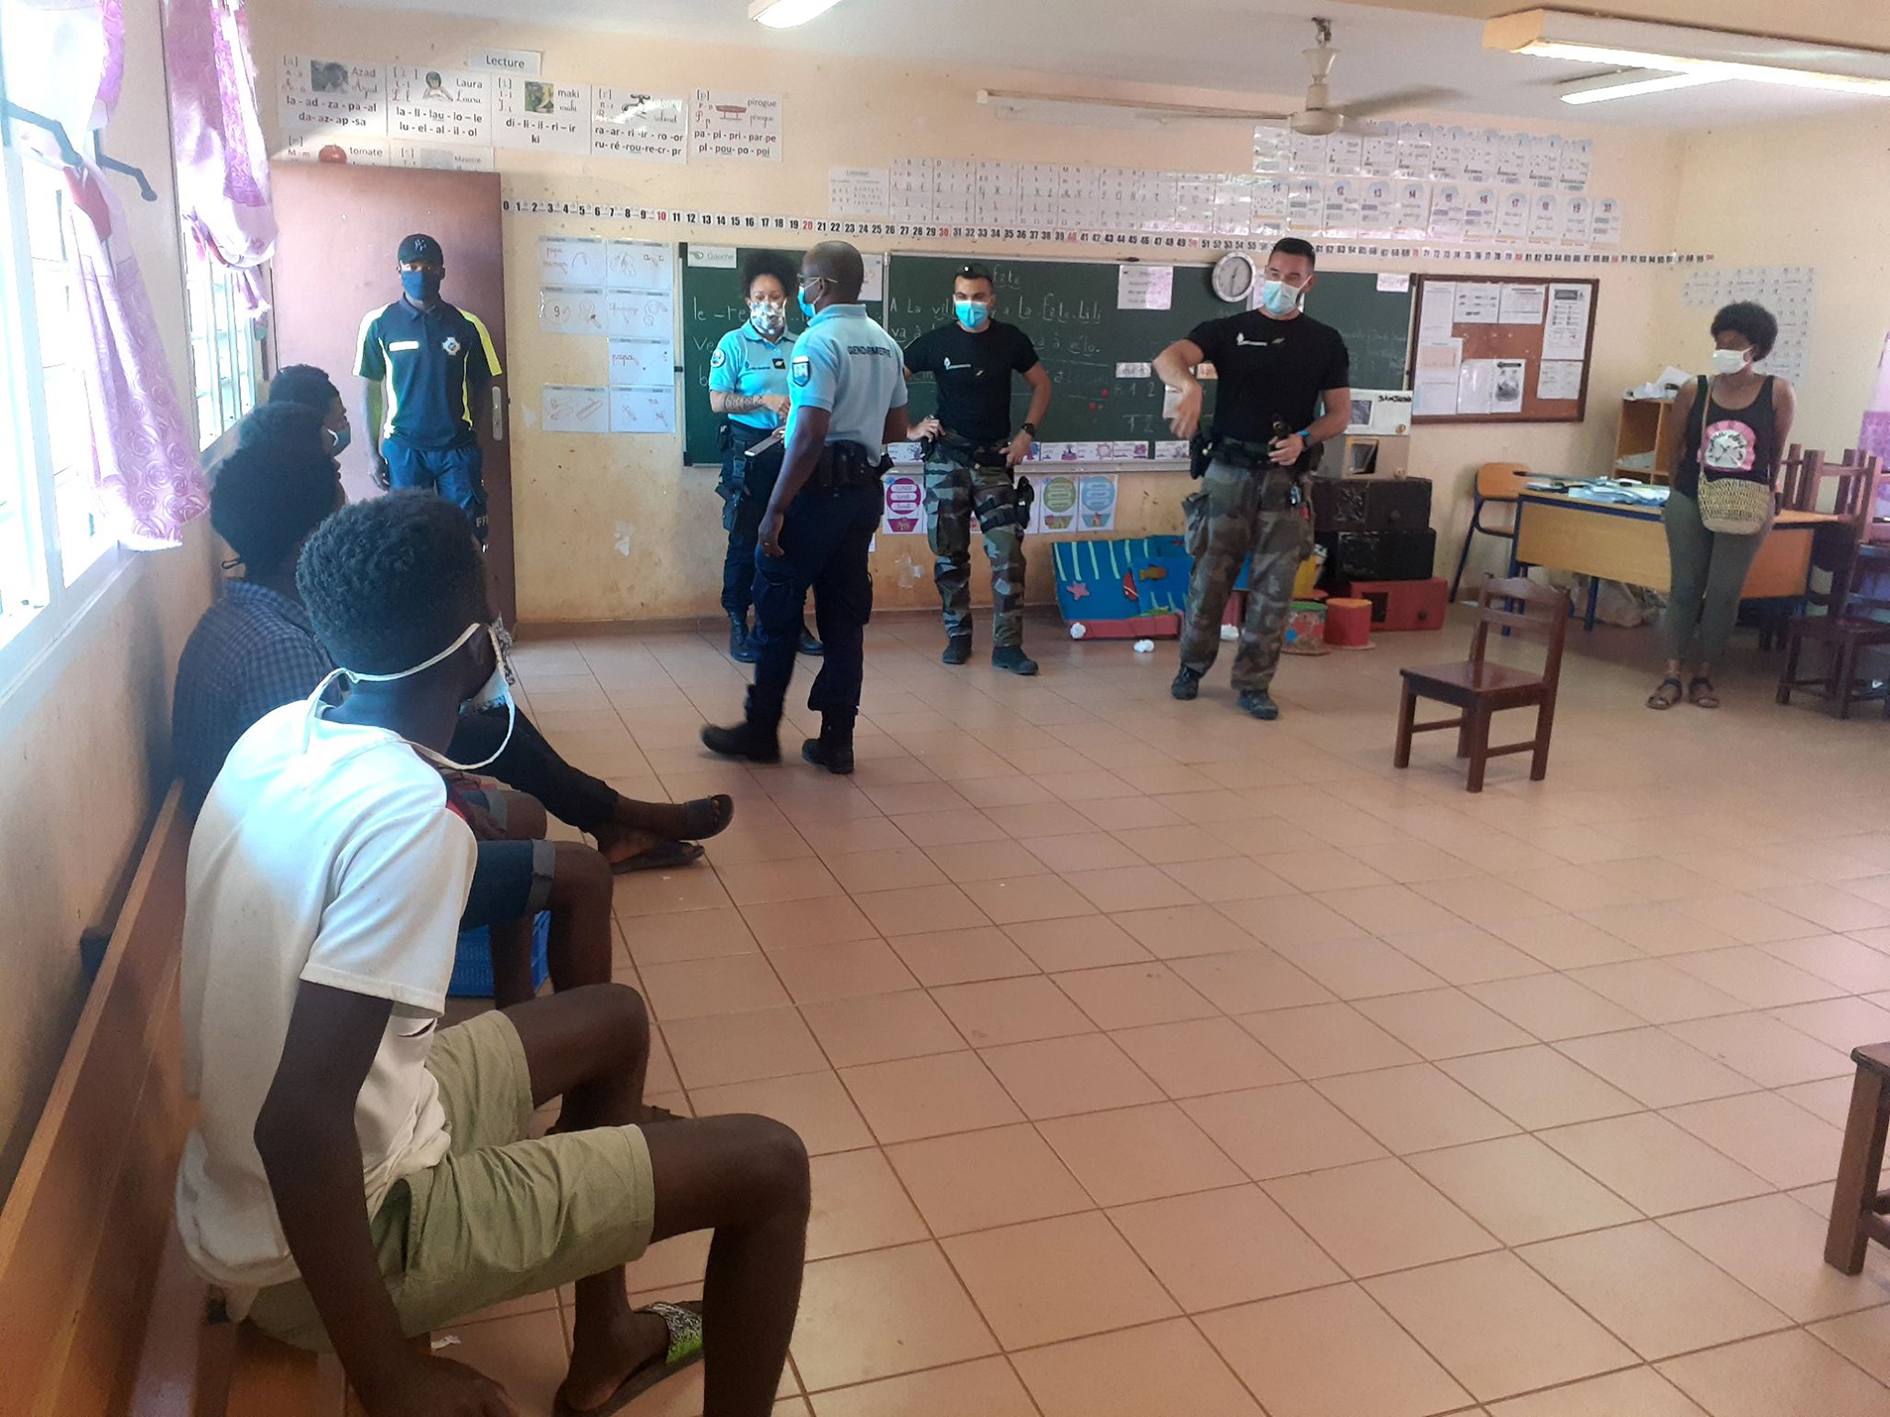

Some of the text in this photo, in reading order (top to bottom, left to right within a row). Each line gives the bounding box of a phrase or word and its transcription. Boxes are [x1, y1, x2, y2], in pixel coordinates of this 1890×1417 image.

[486, 54, 524, 68] Lecture
[351, 66, 376, 77] Azad
[456, 78, 482, 89] Laura
[558, 89, 579, 98] maki
[286, 95, 296, 105] la
[306, 98, 318, 107] ad
[328, 101, 338, 109] za
[348, 103, 360, 112] pa
[748, 98, 776, 108] pirogue
[396, 106, 405, 116] la
[429, 109, 444, 119] lau
[453, 112, 462, 121] lo
[474, 113, 482, 123] le
[336, 117, 348, 126] ap
[506, 118, 515, 127] di
[568, 124, 576, 132] ir
[400, 122, 408, 130] lu
[418, 124, 426, 132] el
[436, 125, 444, 134] al
[468, 128, 477, 136] ol
[628, 129, 634, 137] ri
[531, 134, 540, 143] ki
[694, 130, 705, 138] pa
[729, 131, 741, 140] pri
[610, 141, 620, 150] ré
[737, 147, 748, 155] po
[350, 147, 382, 156] tomate
[503, 201, 509, 211] 0
[516, 202, 521, 211] 1
[532, 203, 538, 212] 2
[547, 203, 553, 213] 3
[563, 204, 568, 214] 4
[579, 205, 585, 216] 5
[594, 207, 600, 216] 6
[609, 207, 614, 217] 7
[625, 208, 631, 218] 8
[640, 210, 646, 220] 9
[657, 211, 666, 221] 10
[672, 212, 680, 222] 11
[687, 213, 696, 223] 12
[702, 215, 712, 224] 13
[717, 215, 726, 225] 14
[731, 217, 740, 226] 15
[745, 217, 754, 227] 16
[762, 218, 770, 227] 17
[775, 218, 784, 228] 18
[790, 220, 798, 230] 19
[803, 221, 813, 231] 20
[817, 222, 826, 232] 21
[830, 222, 840, 232] 22
[845, 223, 854, 233] 23
[859, 224, 868, 234] 24
[872, 224, 882, 234] 25
[885, 225, 895, 234] 26
[900, 225, 910, 235] 27
[913, 226, 922, 236] 28
[926, 227, 936, 237] 29
[939, 227, 948, 237] 30
[953, 227, 962, 237] 31
[965, 227, 975, 237] 32
[978, 228, 987, 237] 33
[991, 228, 1000, 238] 34
[1004, 228, 1014, 238] 35
[1017, 229, 1026, 239] 36
[1029, 230, 1038, 240] 37
[1041, 230, 1050, 240] 38
[1055, 231, 1064, 241] 39
[1080, 232, 1088, 242] 41
[1092, 233, 1100, 242] 42
[1104, 233, 1114, 243] 43
[1117, 234, 1125, 244] 44
[1128, 235, 1137, 244] 45
[1140, 235, 1149, 245] 46
[1154, 236, 1162, 246] 47
[1165, 237, 1174, 247] 48
[1177, 237, 1186, 247] 49
[693, 296, 706, 320] le
[890, 297, 897, 312] A
